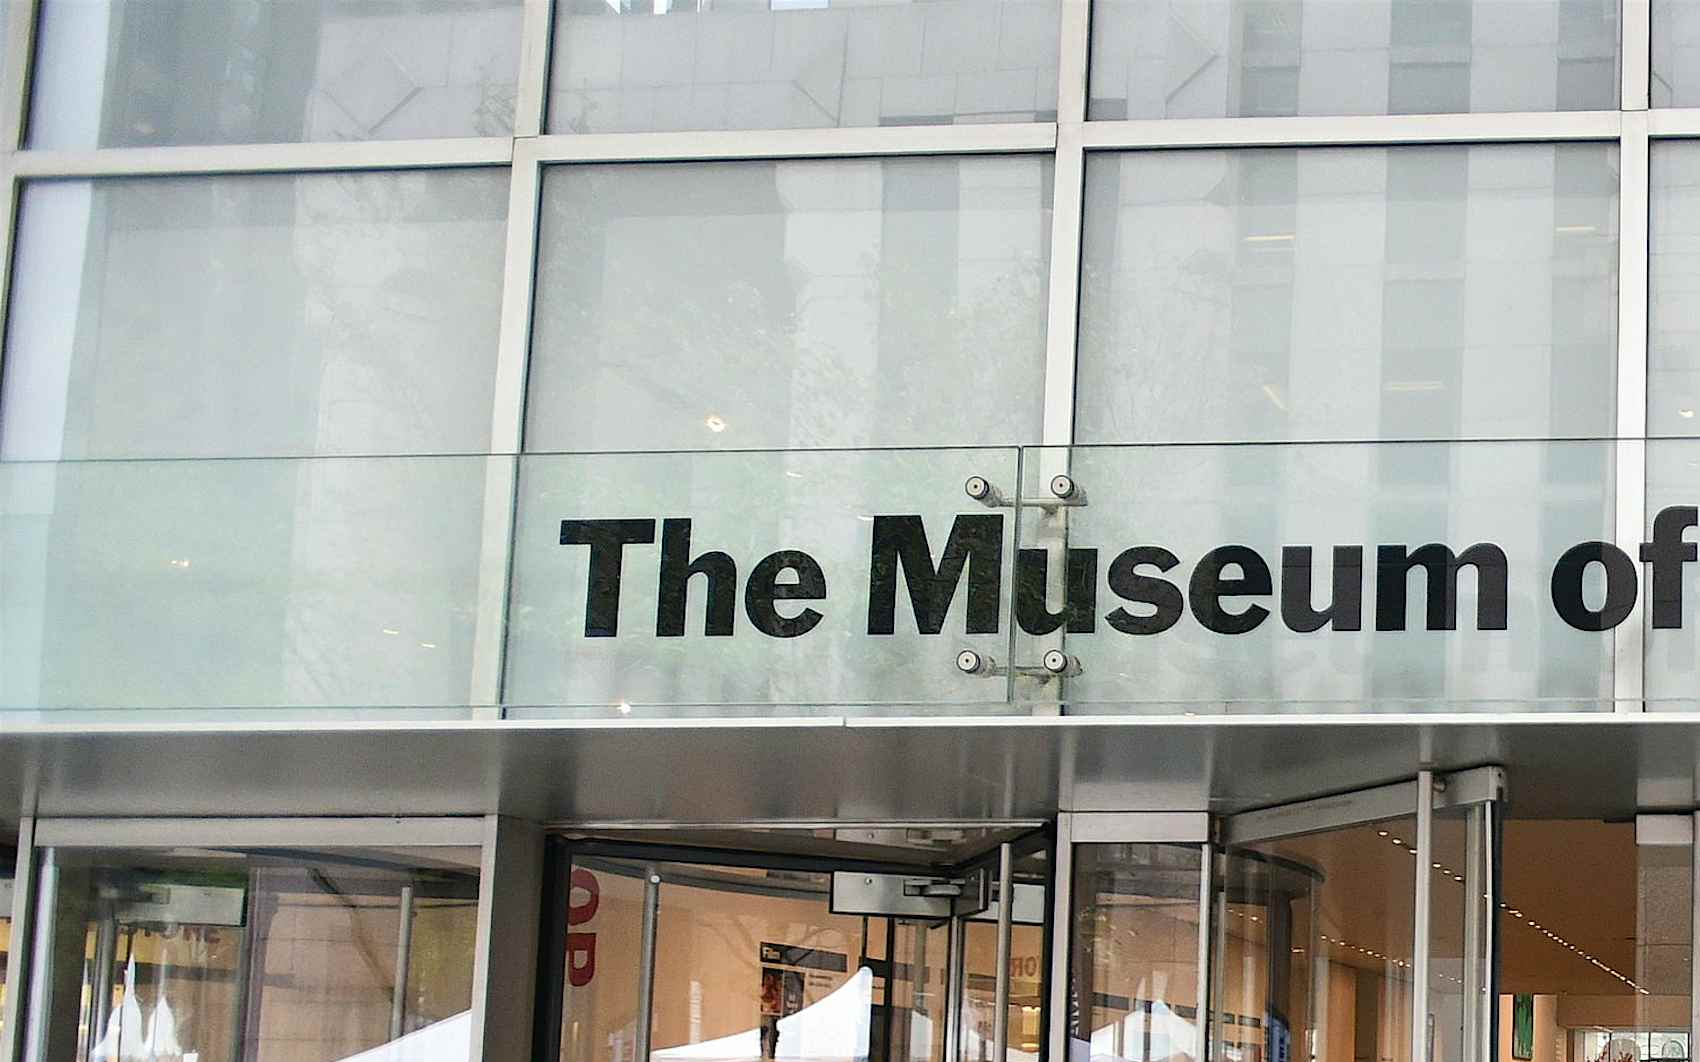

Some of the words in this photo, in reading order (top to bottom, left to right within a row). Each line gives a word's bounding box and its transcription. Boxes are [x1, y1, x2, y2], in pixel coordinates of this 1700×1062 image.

[560, 518, 827, 638] The
[867, 514, 1508, 635] Museum
[1551, 505, 1698, 632] of
